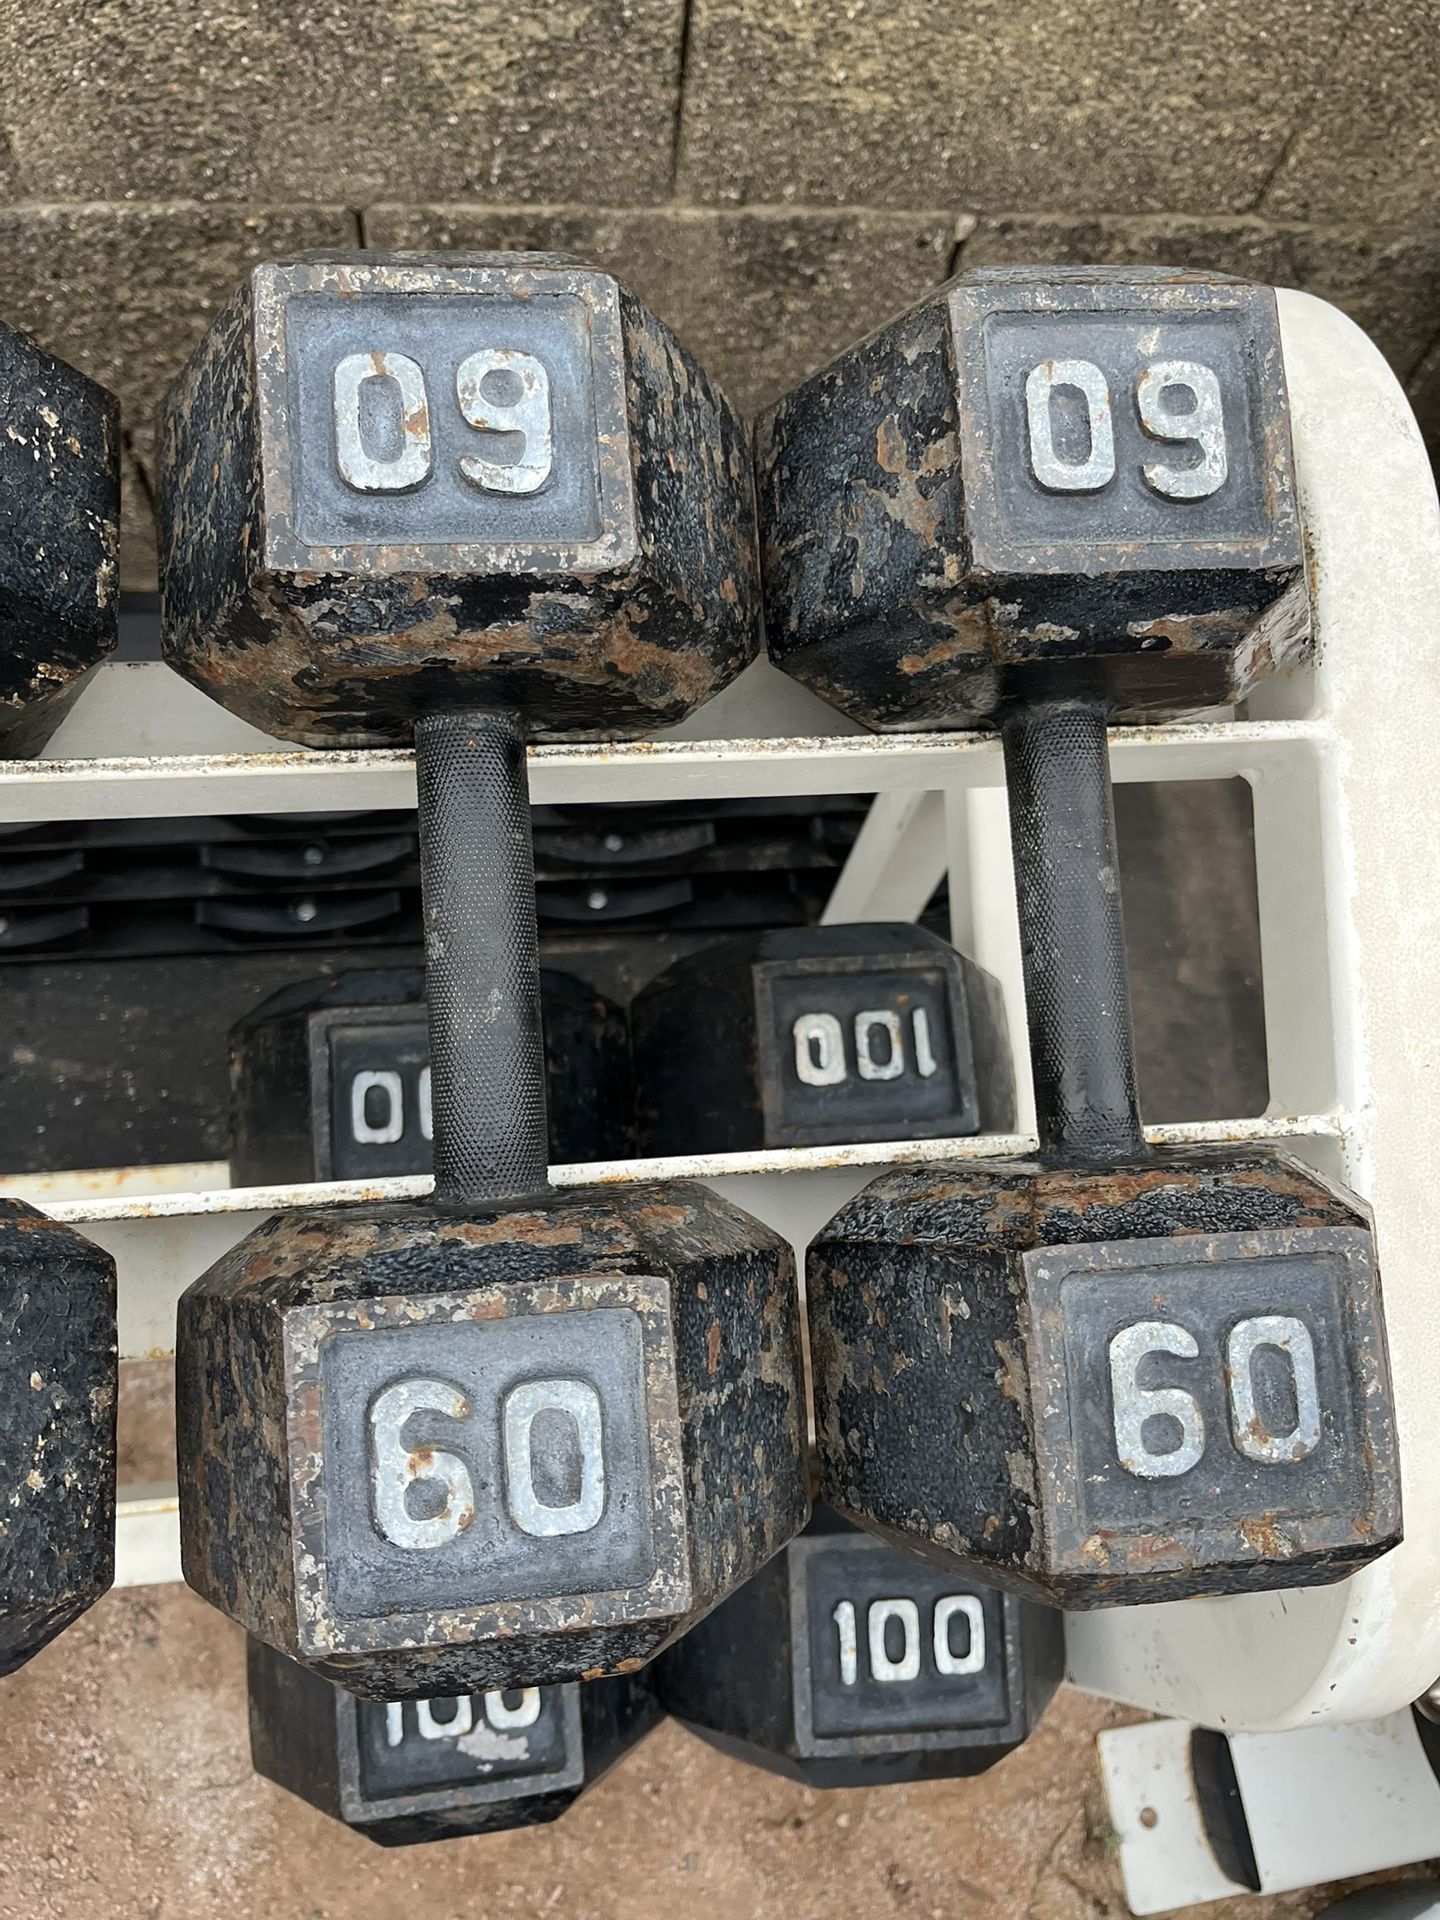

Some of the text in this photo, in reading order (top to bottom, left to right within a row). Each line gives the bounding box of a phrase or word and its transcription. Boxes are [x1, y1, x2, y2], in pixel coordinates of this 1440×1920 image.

[369, 1379, 605, 1550] 60
[1108, 1315, 1321, 1477] 60
[832, 1594, 986, 1686] 100
